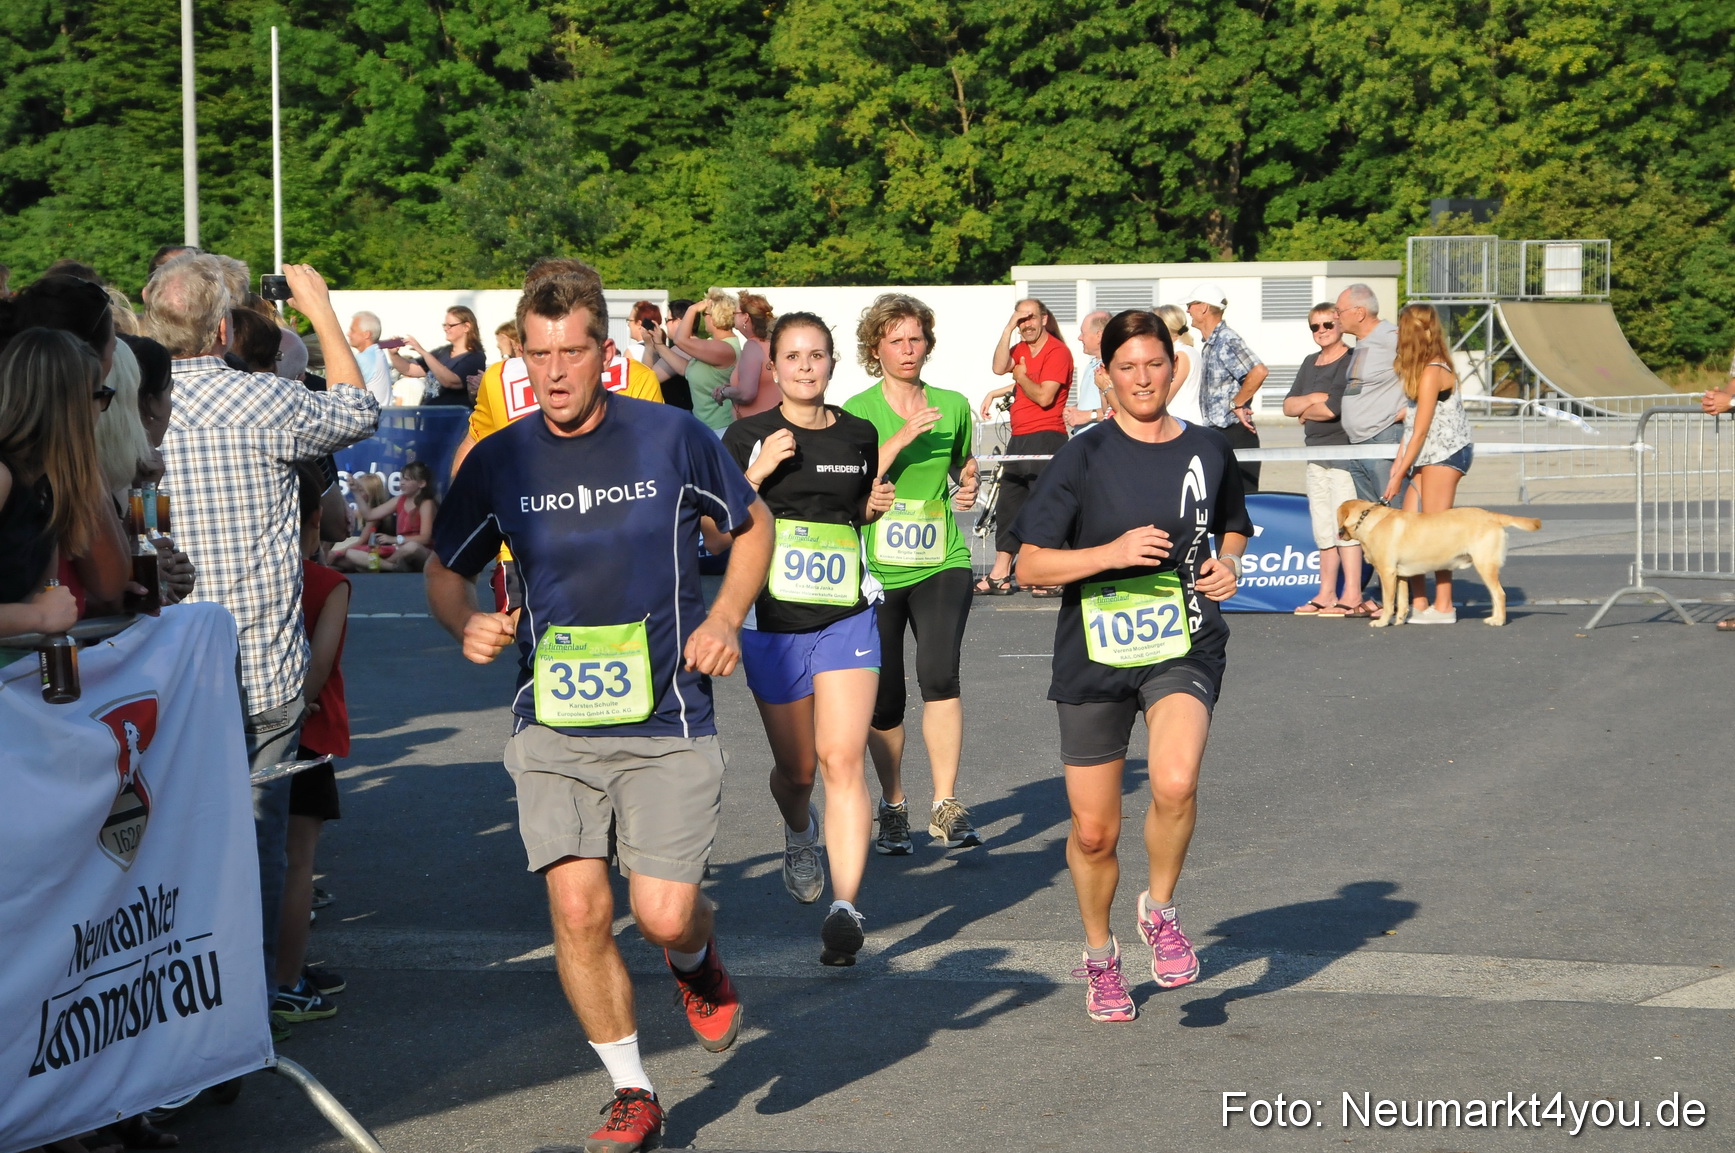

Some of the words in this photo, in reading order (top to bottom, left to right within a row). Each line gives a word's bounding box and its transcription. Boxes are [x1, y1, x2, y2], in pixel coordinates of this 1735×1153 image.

[824, 464, 860, 473] PFLEIDERER
[520, 493, 575, 512] EURO
[595, 480, 657, 506] POLES
[886, 522, 937, 549] 600
[784, 549, 846, 585] 960
[1241, 545, 1321, 574] sche
[1236, 574, 1321, 588] UTOMOBIL
[1089, 603, 1183, 648] 1052
[548, 643, 587, 651] firmenlauf
[549, 660, 632, 701] 353
[586, 709, 605, 717] GmbH
[594, 700, 618, 708] Schulte
[28, 939, 223, 1078] Lammsbräu
